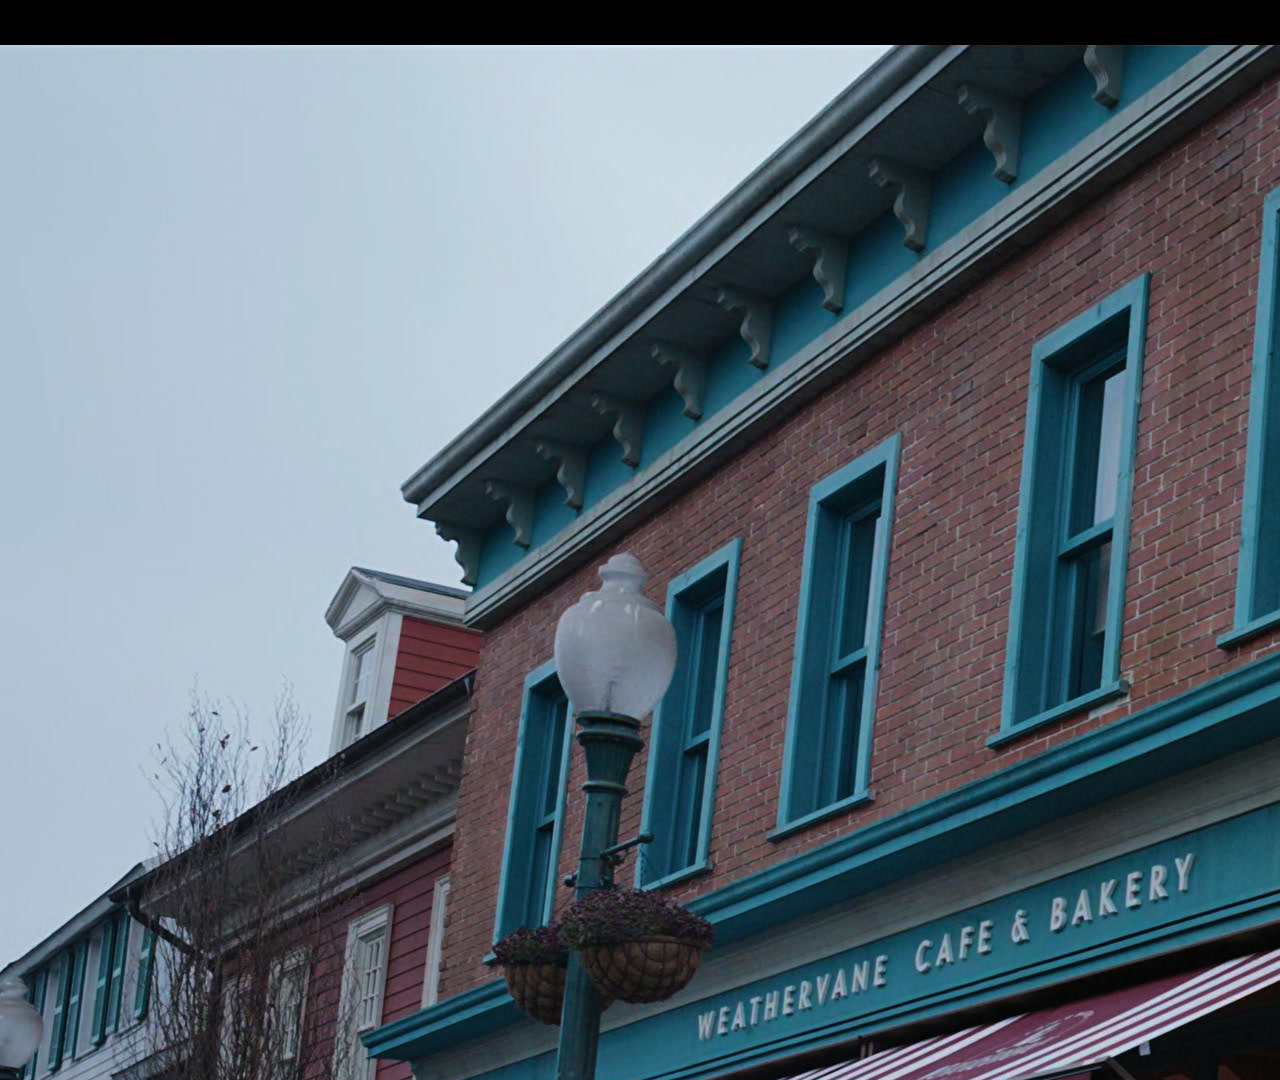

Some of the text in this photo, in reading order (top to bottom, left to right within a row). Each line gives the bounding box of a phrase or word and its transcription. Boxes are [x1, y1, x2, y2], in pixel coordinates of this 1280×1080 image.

[697, 853, 1195, 1040] WEATHERVANE CAFE & BAKERY
